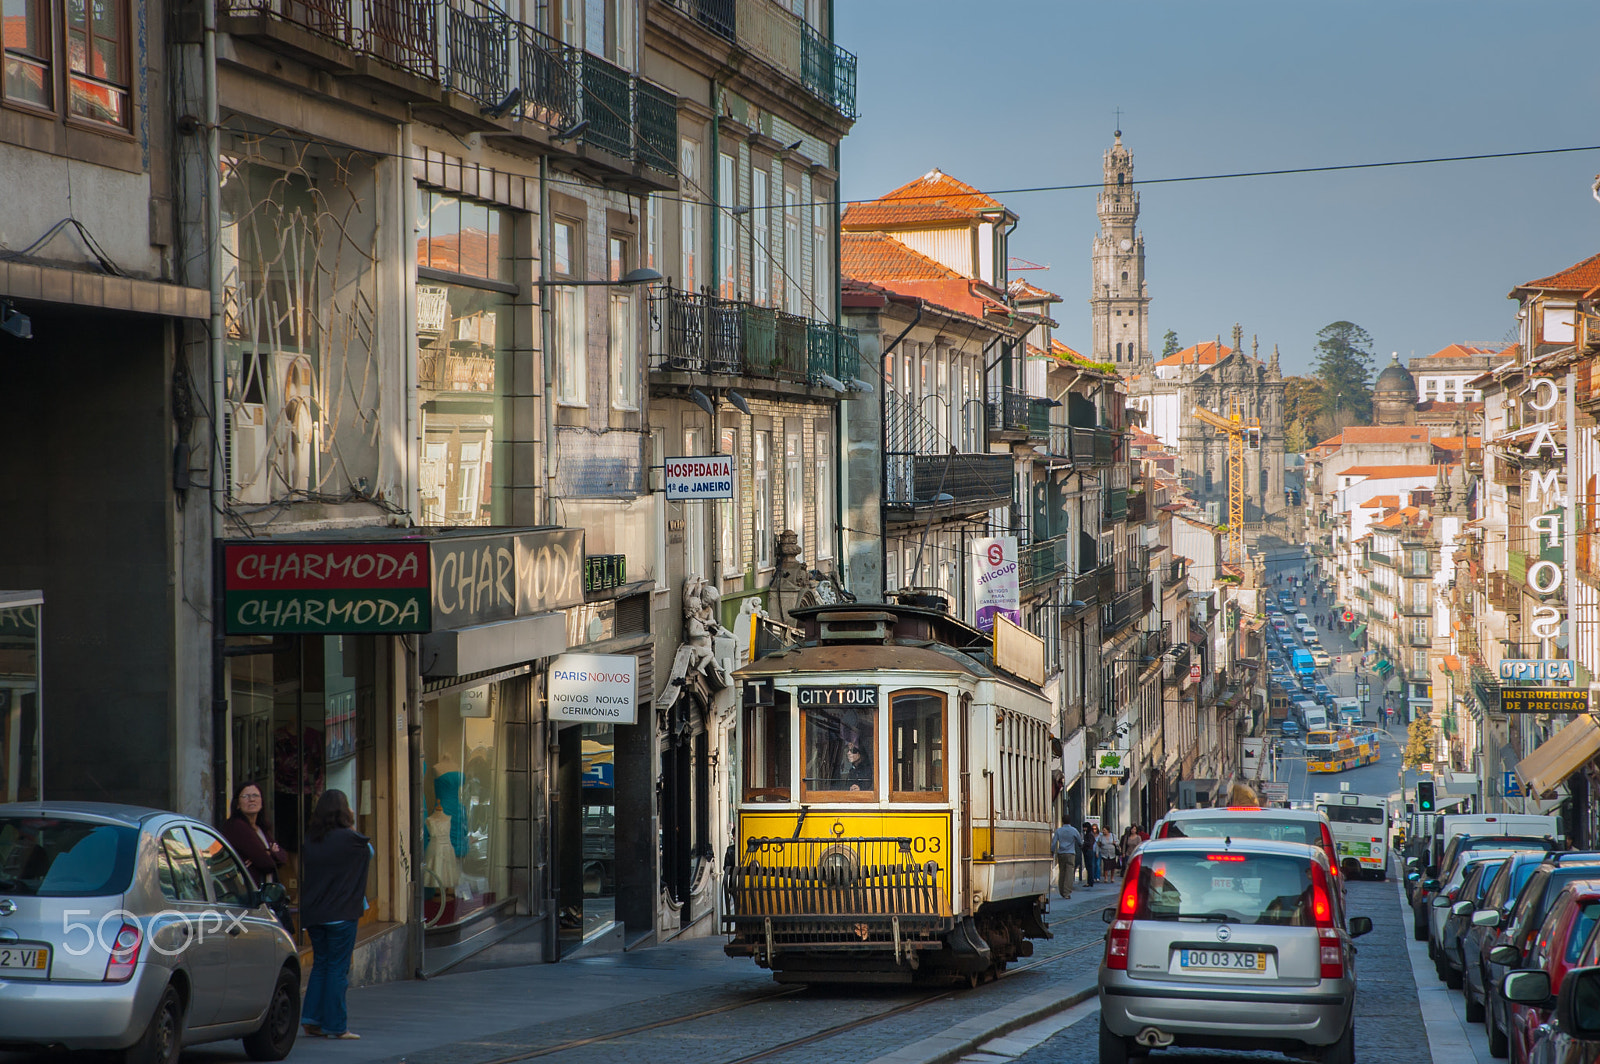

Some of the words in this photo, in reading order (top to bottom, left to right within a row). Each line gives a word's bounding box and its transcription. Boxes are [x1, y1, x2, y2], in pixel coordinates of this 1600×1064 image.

[667, 463, 730, 477] HOSPEDARIA
[678, 483, 689, 493] de
[691, 481, 730, 493] JANEIRO
[236, 551, 419, 580] CHARMODA
[438, 538, 583, 615] CHARMODA
[976, 562, 1017, 586] stilcoup
[237, 597, 420, 626] CHARMODA
[553, 694, 589, 703] NOIVOS
[595, 695, 629, 705] NOIVAS
[748, 681, 767, 704] T
[800, 689, 833, 704] CITY
[836, 689, 875, 704] TOUR
[1502, 690, 1588, 699] INSTRUMENTOS
[562, 706, 620, 717] CERIMÓNIAS
[1506, 702, 1521, 710] DE
[1527, 700, 1585, 710] PRECISÃO
[1190, 951, 1208, 965] 00
[1211, 952, 1229, 966] 03
[1233, 953, 1255, 967] XB
